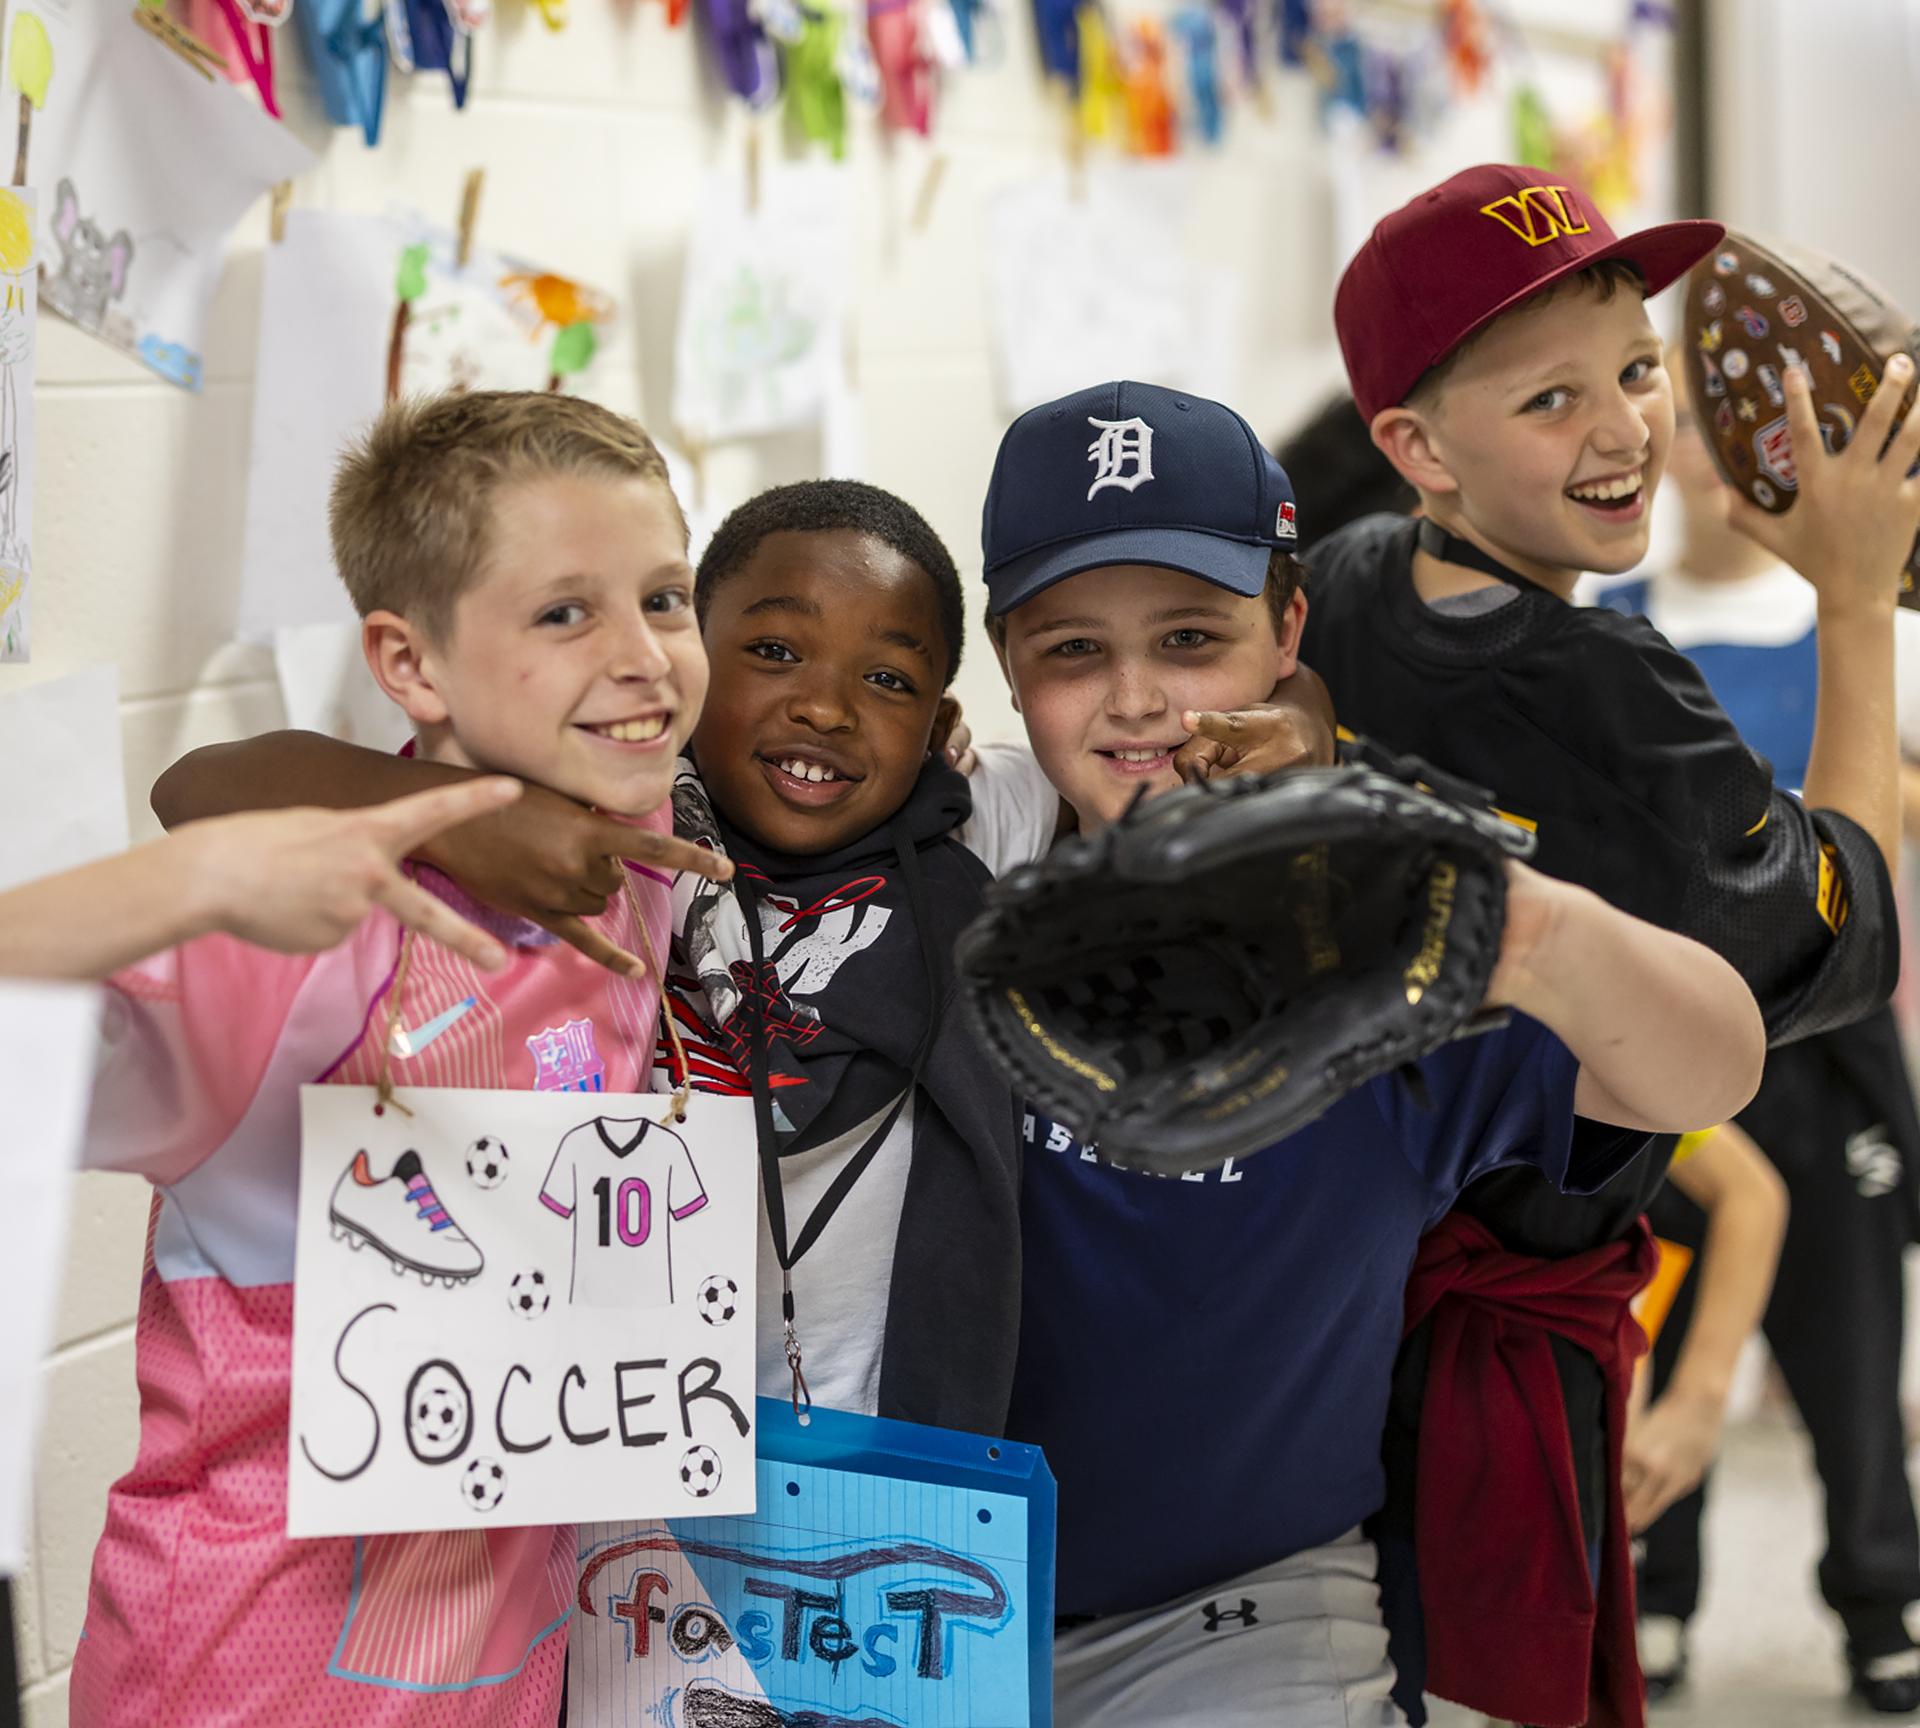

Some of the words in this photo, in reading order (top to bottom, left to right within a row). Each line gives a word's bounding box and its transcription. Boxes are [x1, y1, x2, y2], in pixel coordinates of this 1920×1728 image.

[1087, 416, 1155, 501] D
[592, 1176, 651, 1248] 10
[301, 1303, 750, 1482] SOCCER
